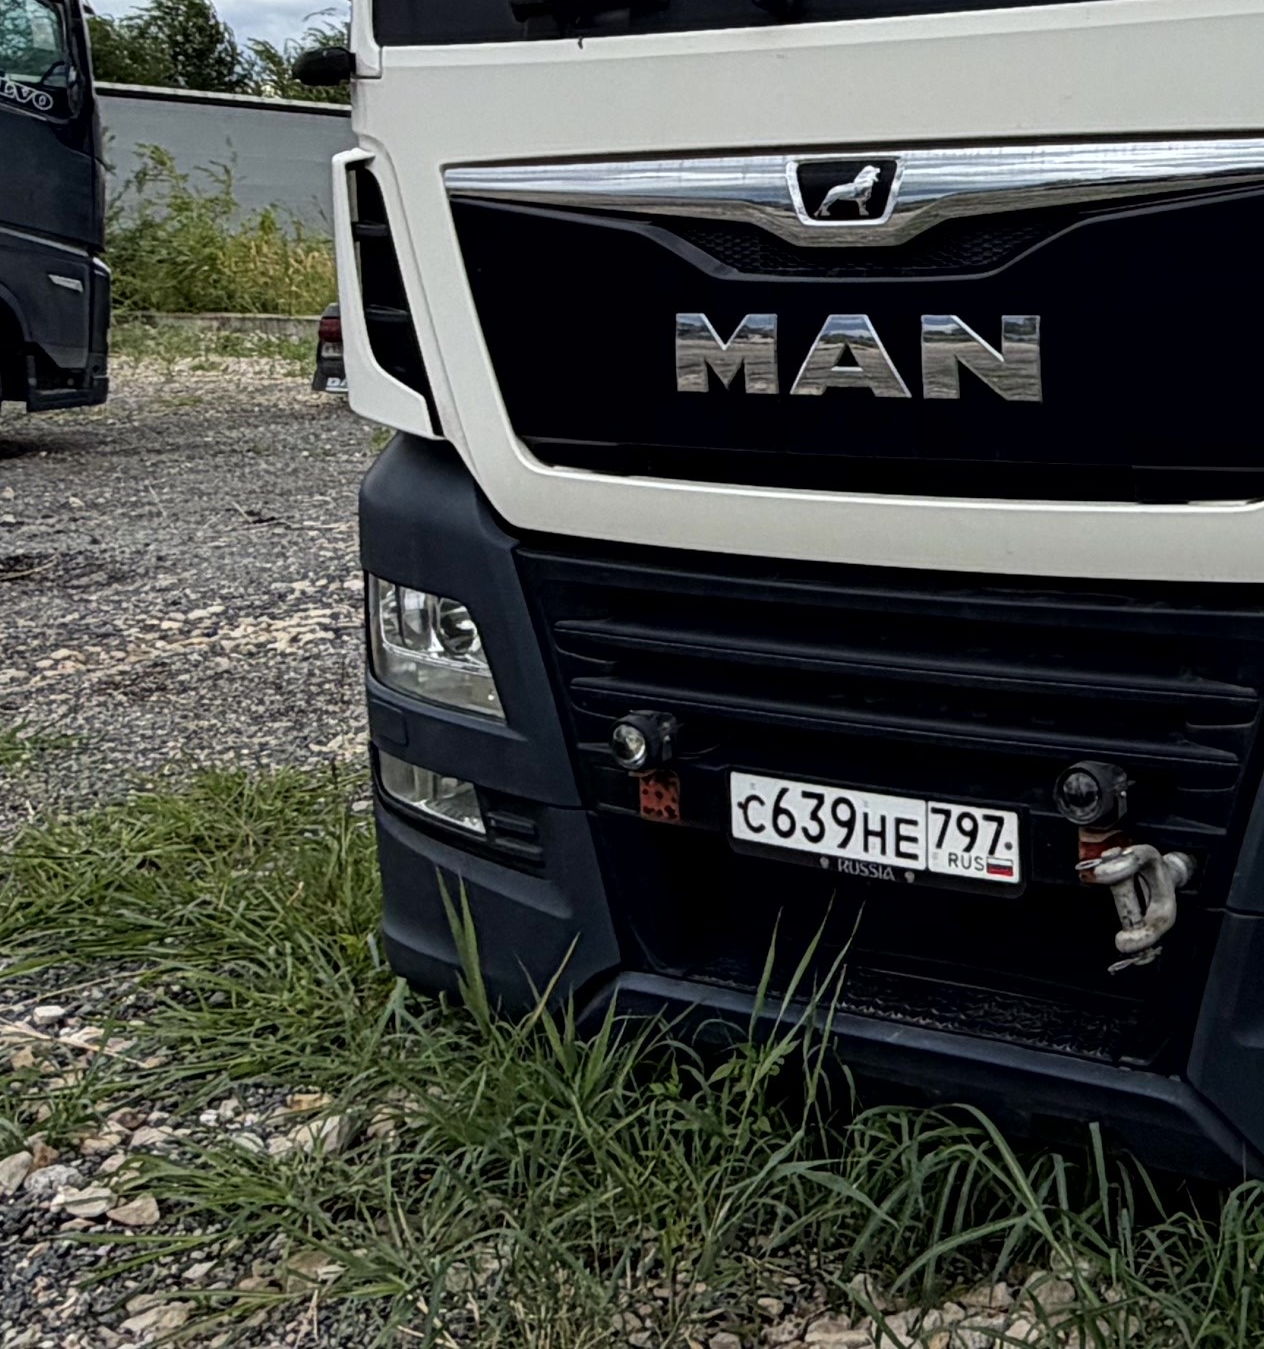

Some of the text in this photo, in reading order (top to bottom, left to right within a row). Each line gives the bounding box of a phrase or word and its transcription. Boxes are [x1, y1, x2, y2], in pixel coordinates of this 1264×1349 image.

[675, 313, 1043, 402] MAN
[740, 787, 1005, 862] C639HE 797
[837, 858, 896, 881] RUSSIA
[948, 852, 985, 872] RUS
